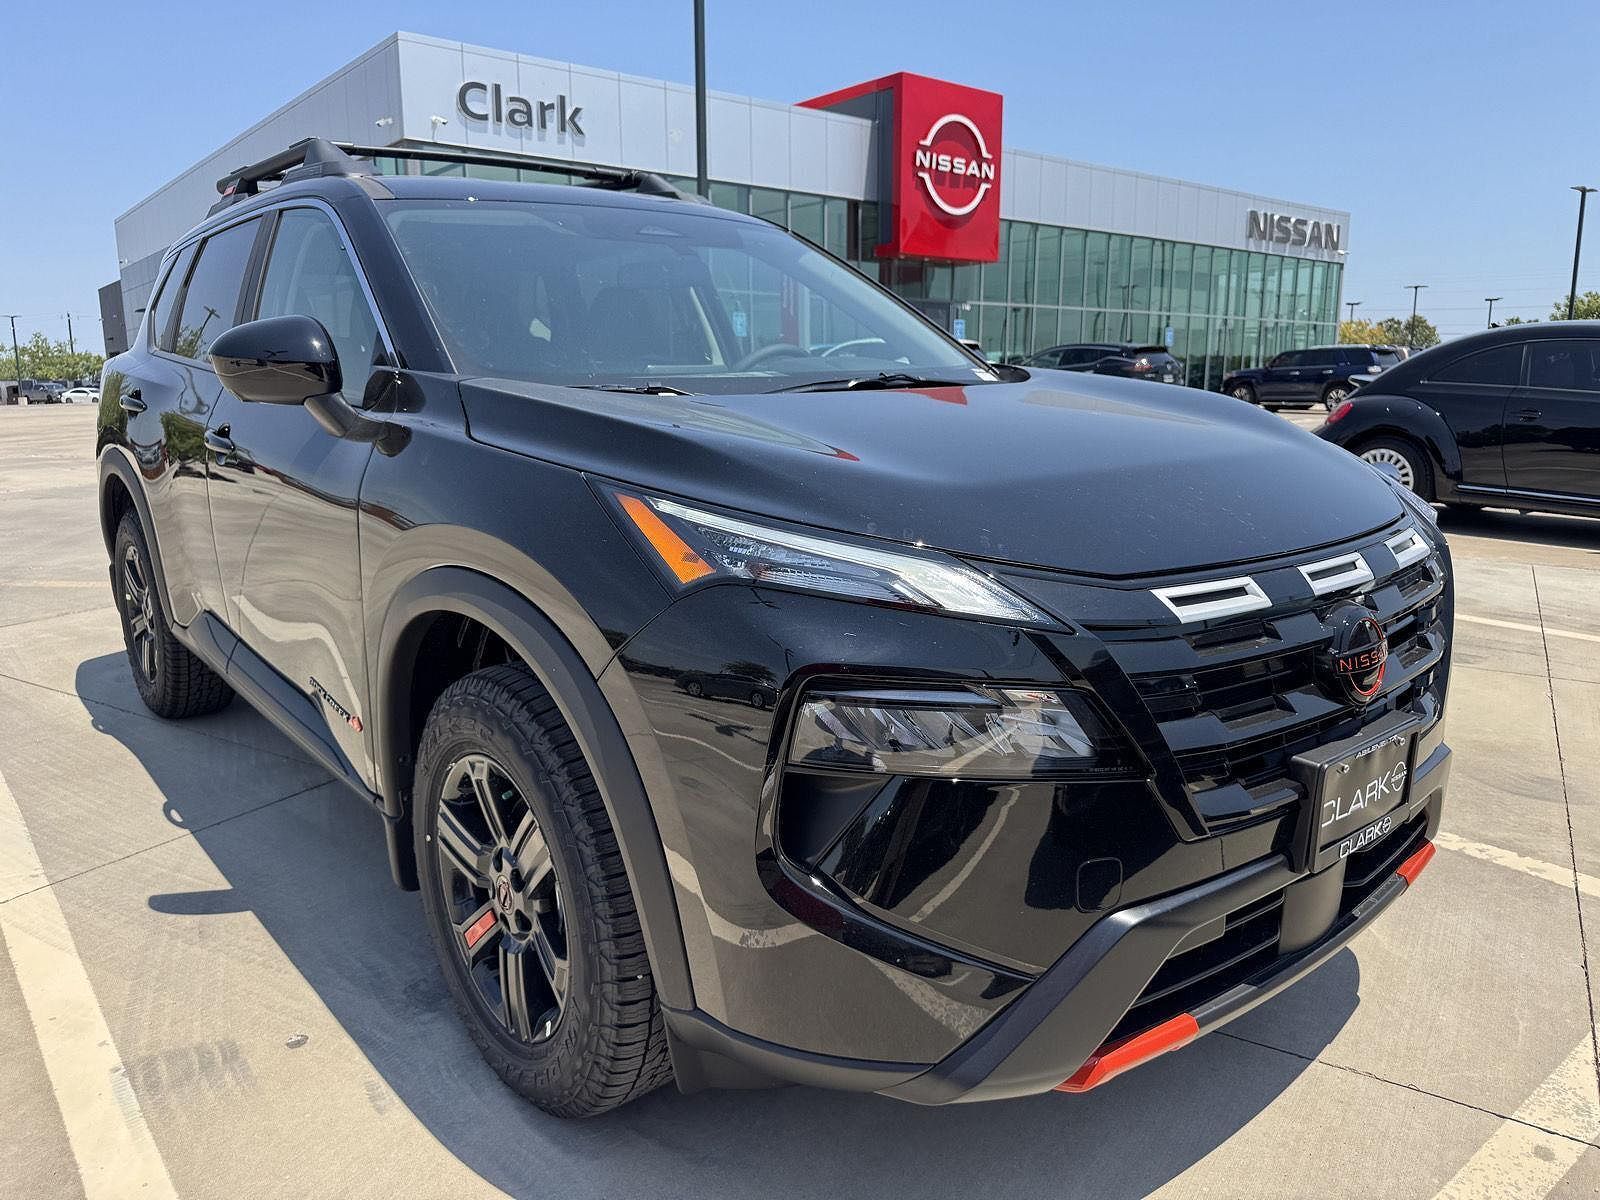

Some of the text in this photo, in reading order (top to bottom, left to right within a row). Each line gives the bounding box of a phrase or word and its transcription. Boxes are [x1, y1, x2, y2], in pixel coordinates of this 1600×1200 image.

[457, 81, 585, 136] Clark
[915, 149, 995, 180] NISSAN
[1247, 209, 1341, 250] NISSAN
[1321, 770, 1391, 828] CLARK
[1339, 820, 1383, 859] CLARK
